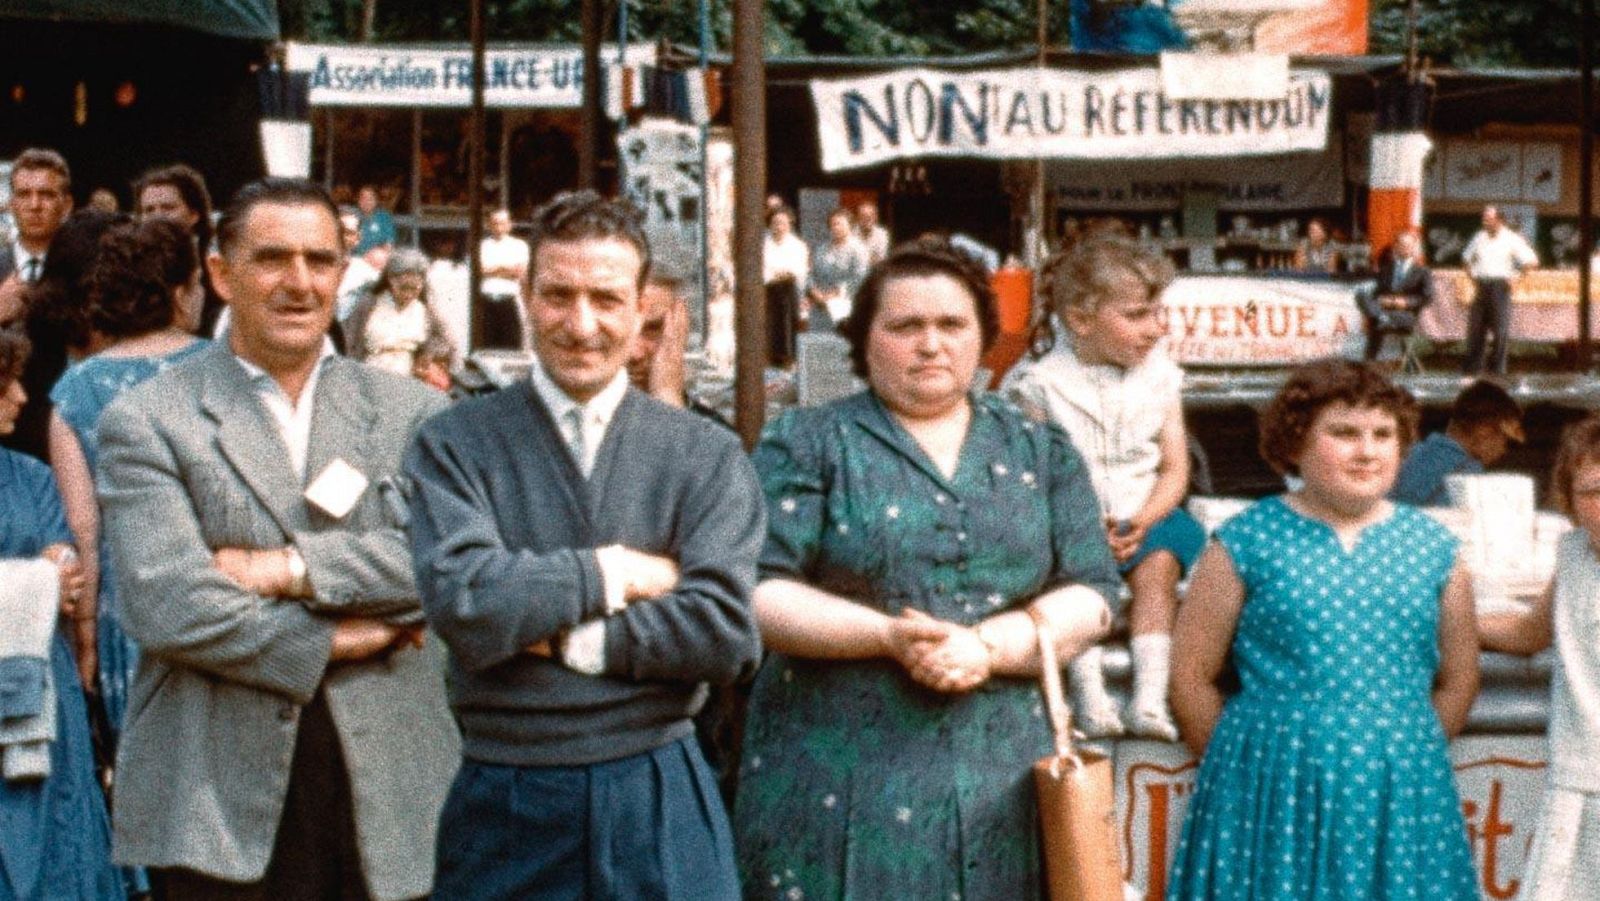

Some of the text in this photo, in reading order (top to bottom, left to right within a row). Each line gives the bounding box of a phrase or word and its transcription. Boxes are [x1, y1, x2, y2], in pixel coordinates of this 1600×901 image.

[309, 54, 437, 91] Association
[841, 77, 990, 155] NON
[1003, 89, 1066, 136] AU
